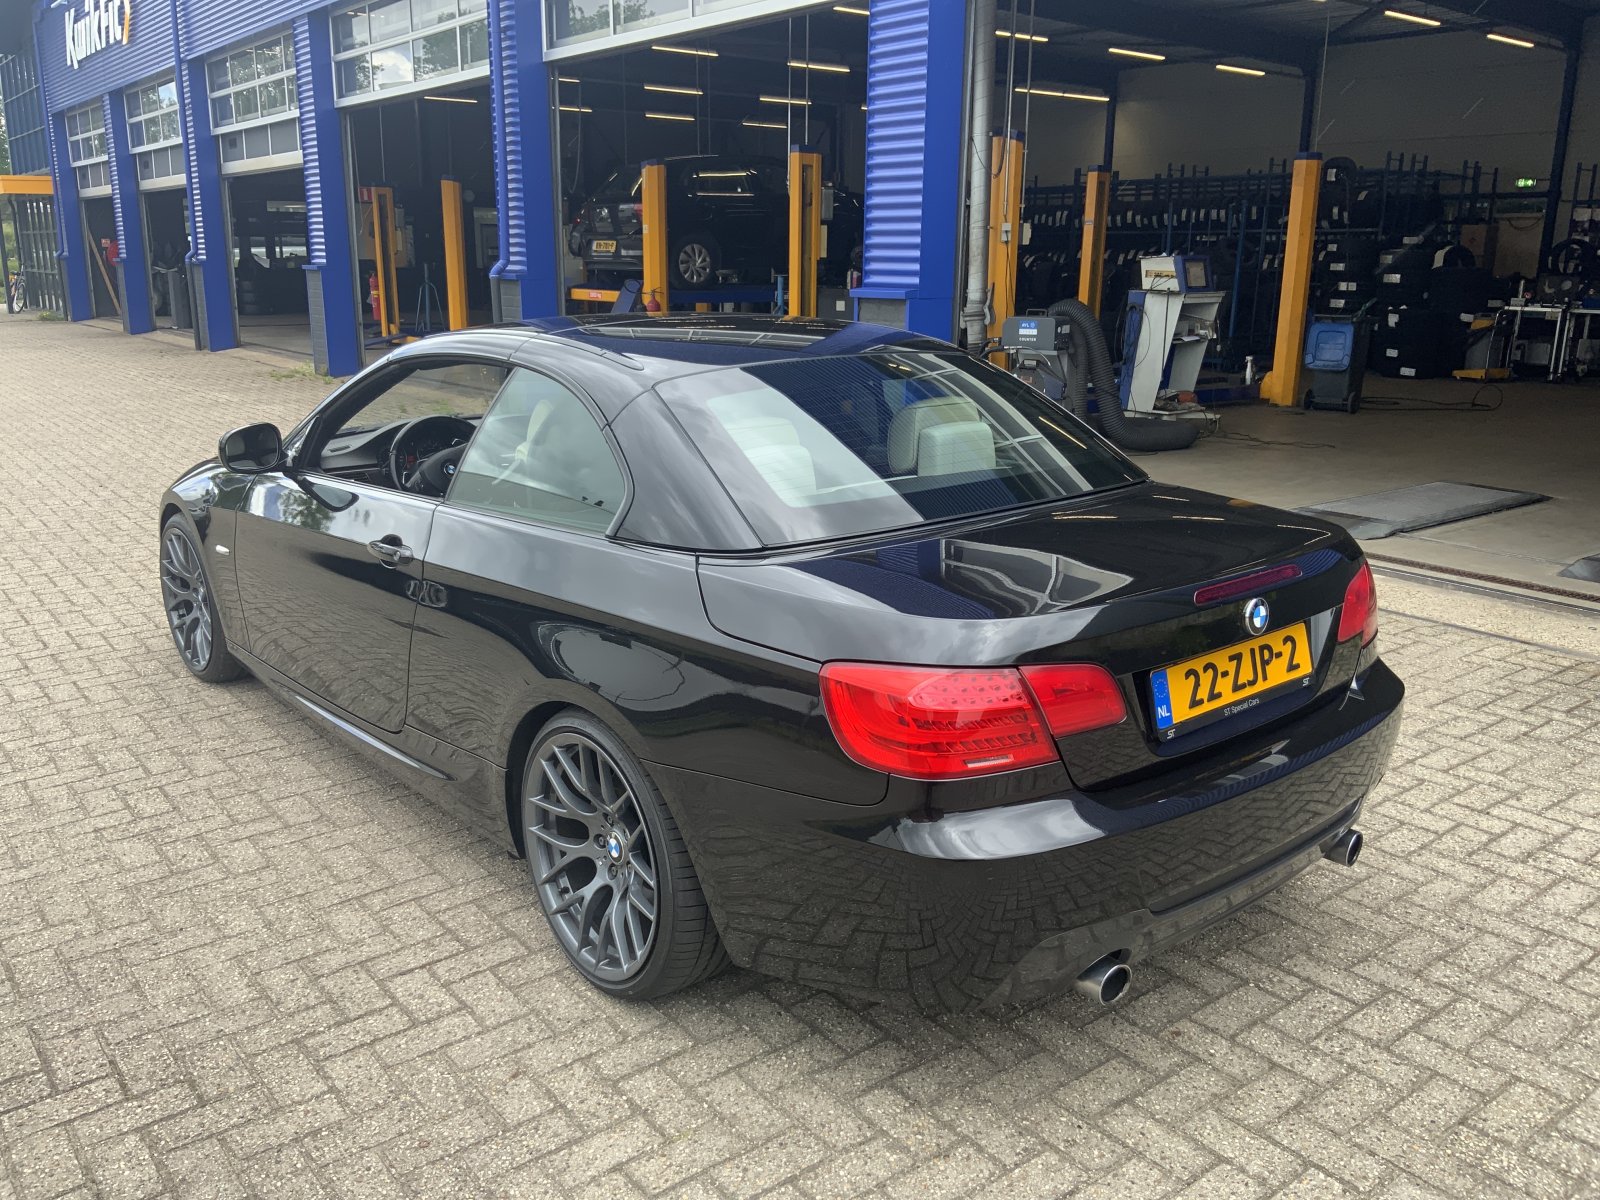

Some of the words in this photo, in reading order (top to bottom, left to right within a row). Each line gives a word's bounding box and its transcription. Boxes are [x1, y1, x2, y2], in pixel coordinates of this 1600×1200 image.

[1184, 635, 1301, 710] 22-ZJP-2
[1157, 704, 1171, 719] NL
[1223, 707, 1231, 716] ST
[1231, 700, 1249, 714] Special
[1248, 697, 1260, 707] Cars
